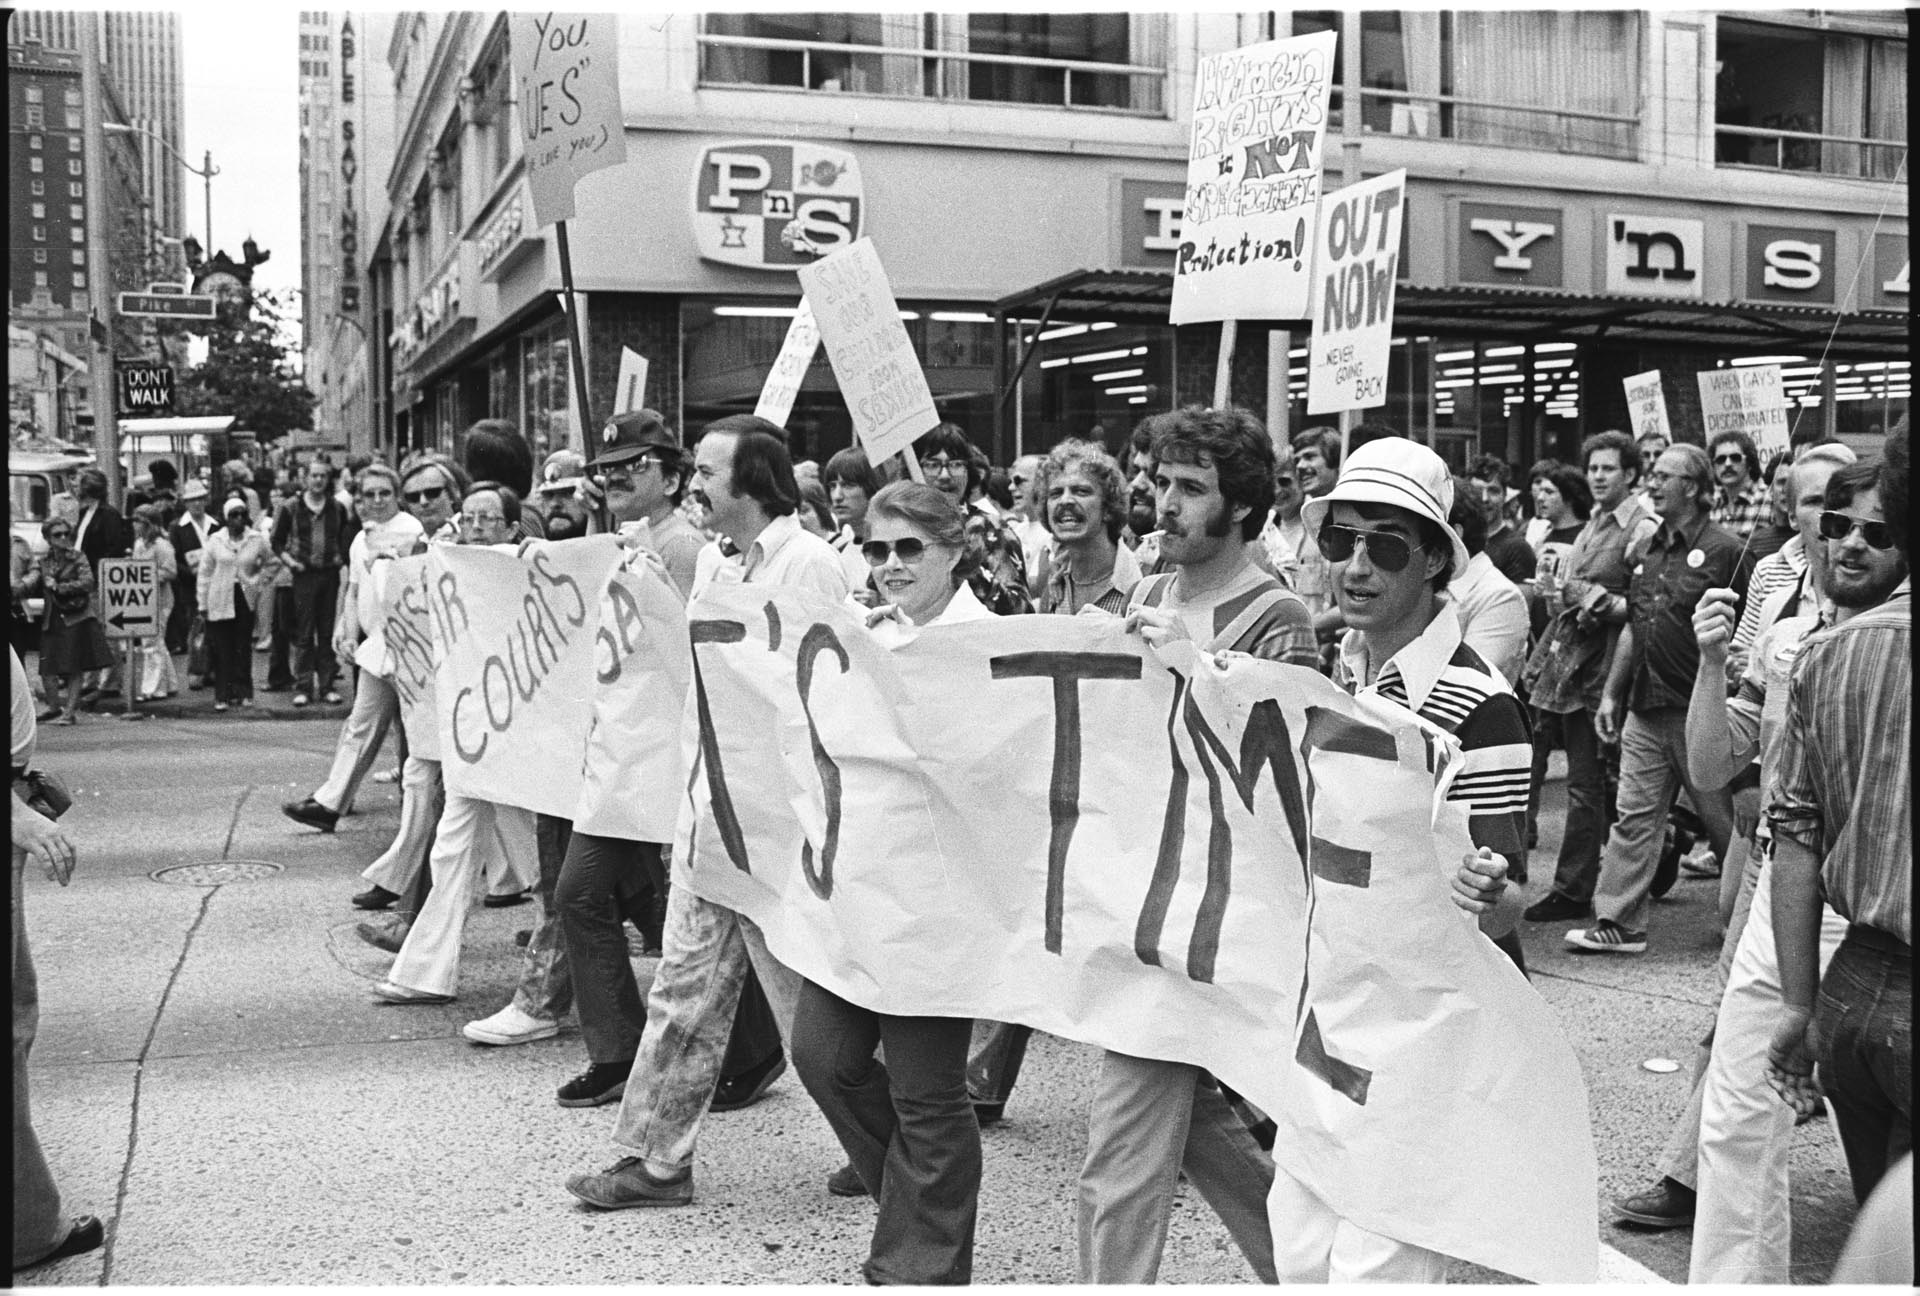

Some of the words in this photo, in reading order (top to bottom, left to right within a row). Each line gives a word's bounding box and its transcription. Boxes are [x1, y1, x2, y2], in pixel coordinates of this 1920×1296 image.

[1219, 154, 1233, 176] is
[1242, 131, 1316, 181] NOT
[1328, 186, 1400, 262] OUT
[1178, 217, 1304, 275] Protection!
[139, 298, 171, 312] Pike
[1323, 253, 1396, 335] NOW
[128, 369, 168, 386] DONT
[1336, 362, 1363, 385] GOING
[1710, 374, 1739, 391] WHEN
[1743, 368, 1776, 388] GAYS
[129, 388, 170, 405] WALK
[1355, 376, 1384, 400] BACK
[1708, 407, 1785, 431] DISCRIMINATED
[108, 566, 152, 585] ONE
[108, 588, 153, 607] WAY
[453, 549, 586, 765] COURTS
[989, 651, 1400, 1106] TIME
